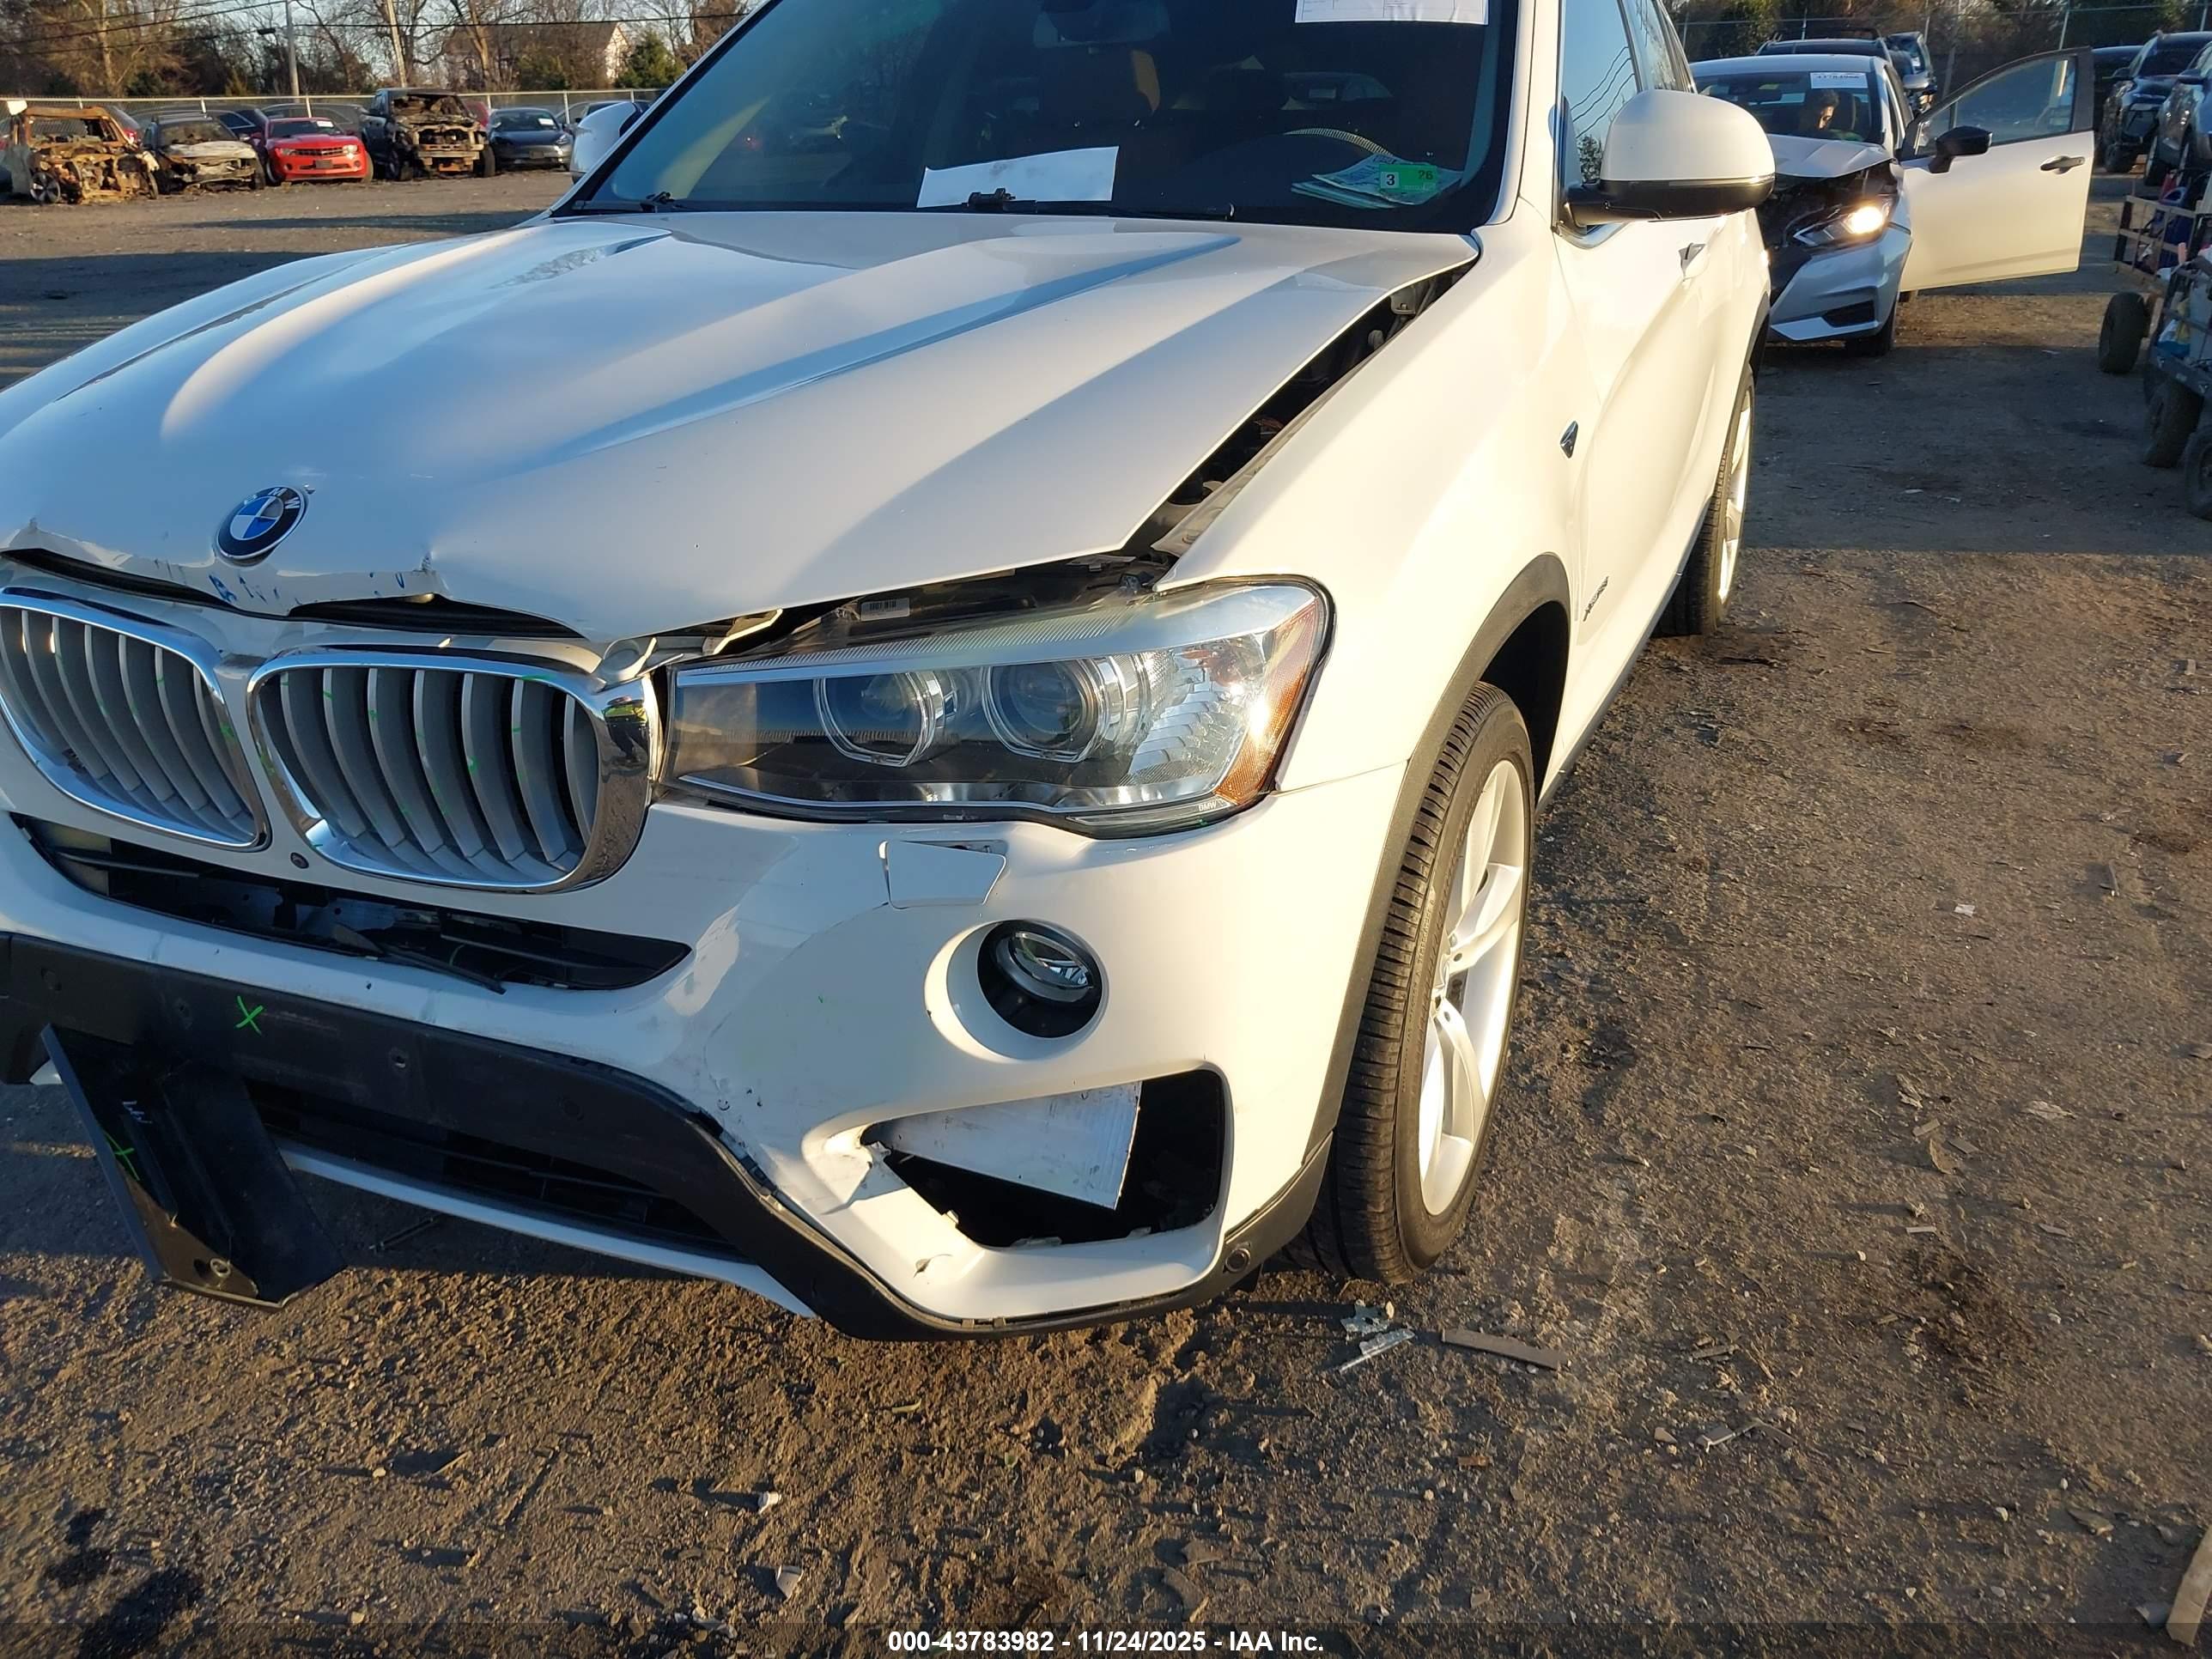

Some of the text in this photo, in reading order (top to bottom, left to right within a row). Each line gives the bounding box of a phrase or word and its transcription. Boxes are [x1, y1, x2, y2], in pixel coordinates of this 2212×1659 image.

[1386, 173, 1395, 185] 3
[1418, 169, 1434, 180] 26
[1198, 799, 1218, 811] BMW
